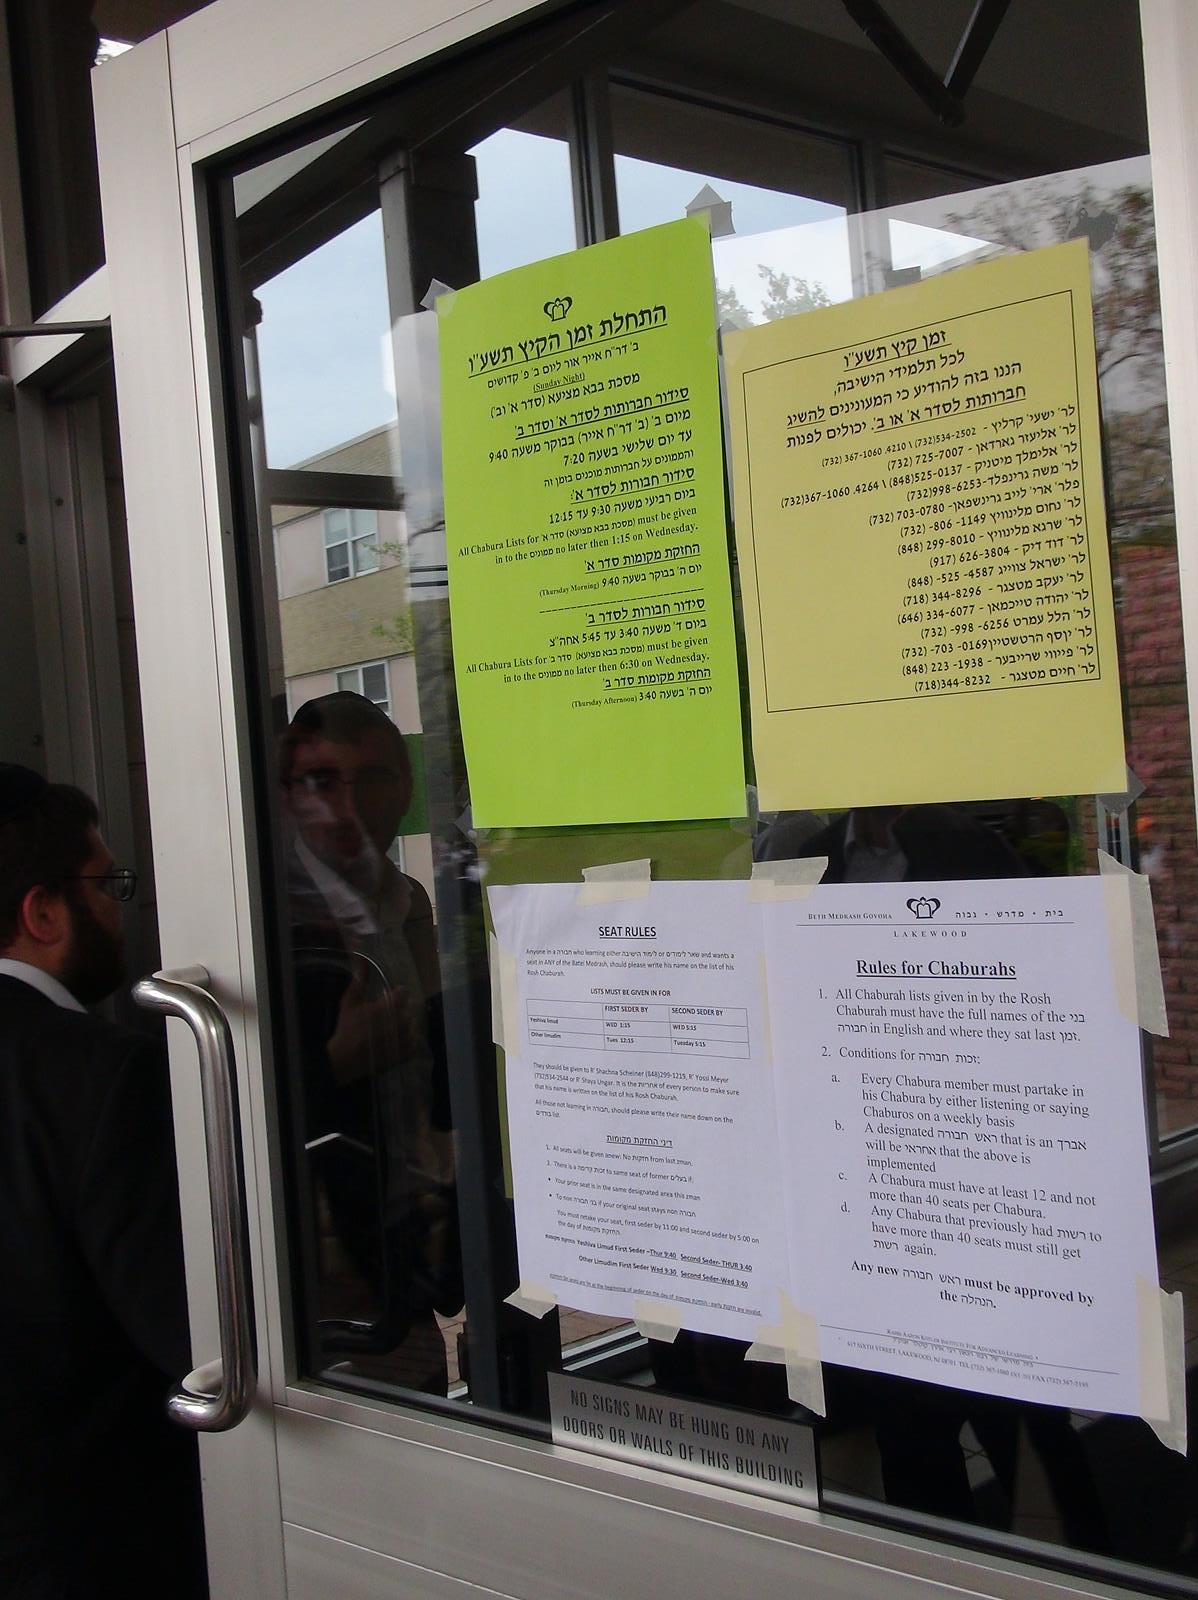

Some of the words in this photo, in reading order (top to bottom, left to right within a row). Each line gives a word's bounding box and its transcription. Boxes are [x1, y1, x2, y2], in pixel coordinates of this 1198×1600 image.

[599, 305, 666, 337] התחלת
[566, 323, 592, 347] זמן
[922, 330, 945, 350] זמן
[517, 333, 560, 359] הקיץ
[891, 337, 916, 357] קיץ
[939, 348, 964, 368] לכל
[888, 359, 936, 378] תלמידי
[993, 362, 1021, 378] הננו
[607, 372, 640, 389] מסכת
[834, 371, 884, 395] הישיבה,
[963, 369, 989, 385] בזה
[582, 381, 604, 395] בבא
[896, 388, 909, 400] כי
[913, 374, 958, 398] להודיע
[547, 387, 580, 404] מציעא
[655, 387, 688, 404] סידור
[965, 385, 1025, 409] חברותות
[603, 396, 652, 416] חברותות
[829, 393, 892, 416] המעונינים
[924, 397, 960, 417] לסדר
[570, 406, 599, 423] לסדר
[787, 405, 824, 426] להשיג
[889, 412, 903, 426] או
[527, 418, 553, 433] וסדר
[826, 421, 866, 439] יכולים
[657, 433, 674, 446] יום
[677, 428, 692, 442] עד
[786, 428, 821, 447] לפנות
[1017, 427, 1056, 443] אליעזר
[621, 437, 654, 453] שלישי
[975, 436, 1014, 455] גארדאן
[563, 451, 584, 466] 7:20
[587, 446, 618, 461] בשעה
[914, 445, 963, 464] 725-7007
[644, 493, 671, 507] רביעי
[674, 488, 695, 500] ביום
[575, 508, 588, 519] עד
[591, 503, 610, 517] 9:30
[613, 498, 642, 513] משעה
[549, 510, 573, 524] 12:15
[495, 555, 502, 564] in
[505, 554, 513, 562] to
[514, 551, 527, 560] the
[529, 547, 553, 558] ממונים
[555, 546, 565, 554] no
[567, 542, 587, 551] later
[589, 538, 608, 548] then
[612, 532, 630, 544] 1:15
[632, 533, 642, 541] on
[644, 522, 698, 538] Wednesday.
[641, 623, 671, 636] משעה
[685, 618, 707, 629] ביום
[582, 631, 600, 643] 5:45
[603, 629, 616, 640] עד
[619, 626, 639, 638] 3:40
[598, 926, 622, 936] SEAT
[625, 926, 656, 936] RULES
[856, 960, 896, 974] Rules
[901, 960, 923, 974] for
[928, 960, 1015, 976] Chaburahs
[590, 987, 604, 995] LISTS
[819, 988, 827, 999] 1.
[835, 988, 851, 999] All
[854, 988, 905, 1000] Chaburah
[908, 989, 930, 1001] lists
[933, 990, 964, 1004] given
[967, 991, 978, 1002] in
[980, 991, 995, 1006] by
[998, 991, 1016, 1003] the
[1020, 992, 1051, 1004] Rosh
[673, 1039, 694, 1047] Tuesday
[831, 1074, 840, 1082] a.
[861, 1072, 892, 1087] Every
[895, 1074, 941, 1088] Chabura
[944, 1078, 989, 1091] member
[992, 1083, 1020, 1093] must
[1023, 1083, 1068, 1097] partake
[1072, 1084, 1084, 1096] in
[606, 1134, 632, 1144] מקומות
[632, 1136, 659, 1146] החזקת
[658, 1139, 672, 1147] דיני
[838, 1172, 847, 1180] c.
[868, 1172, 878, 1183] A
[880, 1172, 926, 1188] Chabura
[928, 1180, 955, 1191] must
[958, 1180, 985, 1194] have
[988, 1186, 998, 1196] at
[1002, 1184, 1028, 1199] least
[1033, 1188, 1046, 1201] 12
[1050, 1191, 1072, 1204] and
[1075, 1196, 1095, 1206] not
[851, 1260, 873, 1275] Any
[877, 1265, 897, 1275] new
[902, 1268, 933, 1280] חבורה
[938, 1274, 961, 1284] ראש
[964, 1278, 992, 1290] must
[996, 1280, 1010, 1293] be
[939, 1289, 957, 1302] the
[960, 1293, 996, 1308] הנהלה.
[1014, 1286, 1073, 1301] approved
[1078, 1291, 1093, 1307] by
[570, 1389, 587, 1407] NO
[592, 1393, 630, 1417] SIGNS
[635, 1403, 663, 1424] MAY
[669, 1411, 685, 1430] BE
[691, 1415, 729, 1440] HUNG
[735, 1425, 754, 1446] ON
[761, 1432, 789, 1454] ANY
[562, 1415, 603, 1439] DOORS
[609, 1426, 625, 1445] OR
[630, 1431, 672, 1456] WALLS
[678, 1442, 694, 1461] OF
[699, 1447, 729, 1470] THIS
[735, 1455, 803, 1488] BUILDING
